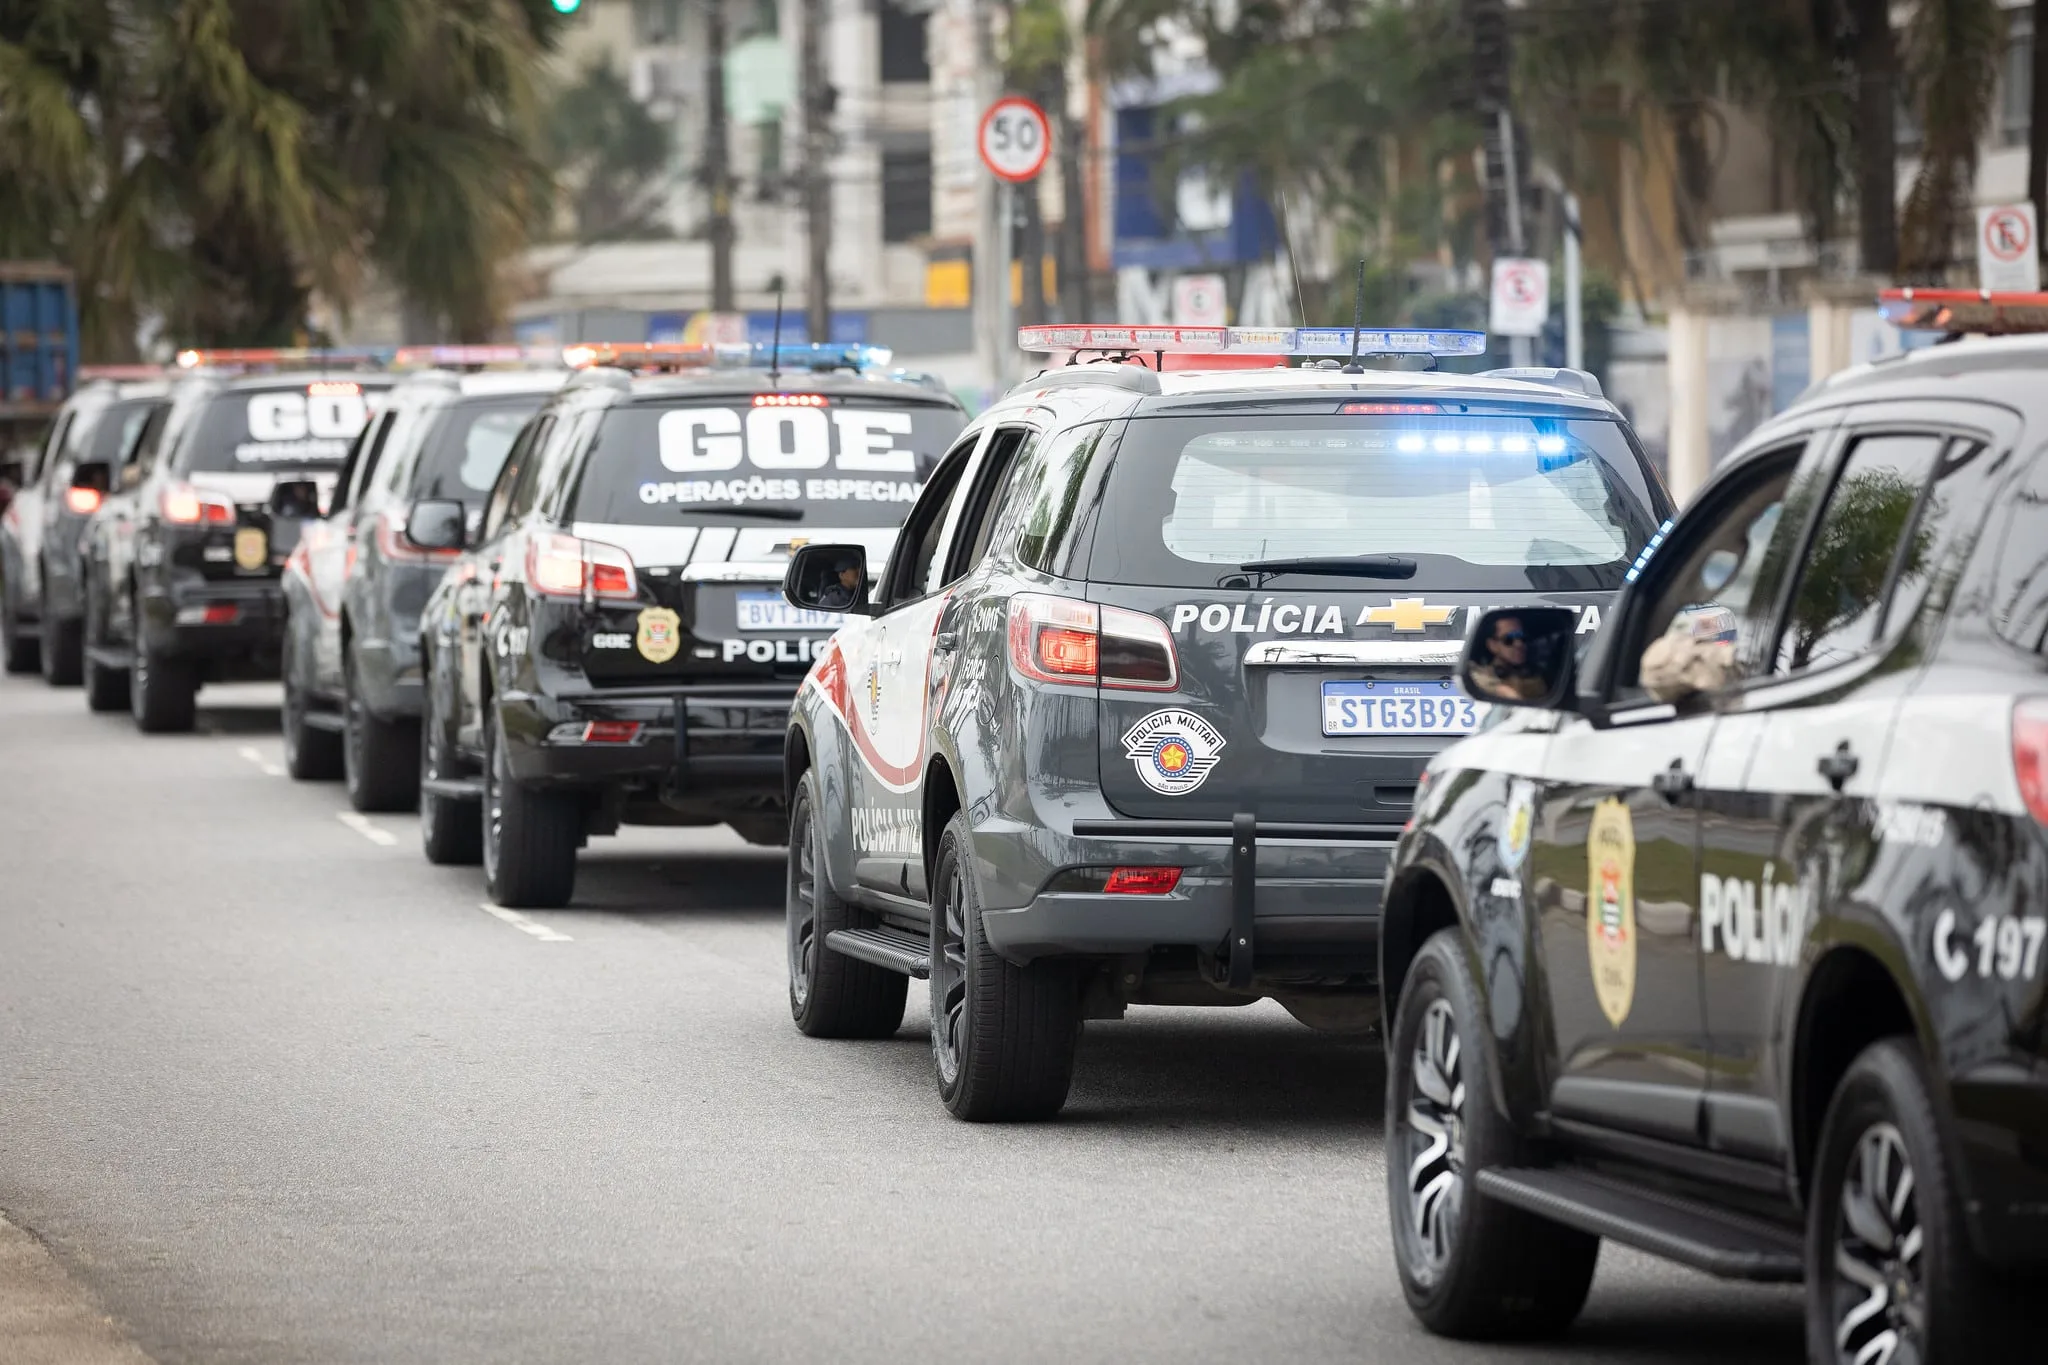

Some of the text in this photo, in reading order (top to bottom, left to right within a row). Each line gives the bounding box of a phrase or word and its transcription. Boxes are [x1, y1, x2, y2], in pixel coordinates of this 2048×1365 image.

[993, 116, 1037, 151] 50
[247, 392, 374, 441] GO
[658, 407, 916, 472] GOE
[639, 475, 926, 505] OPERAÇÕES ESPECIAI
[1171, 598, 1344, 634] POLÍCIA
[1130, 714, 1217, 747] POLÍCIA MILITAR
[1328, 720, 1338, 730] BR
[1341, 698, 1476, 728] STG3B93
[851, 796, 896, 853] POLÍCIA
[1974, 914, 2047, 980] 197
